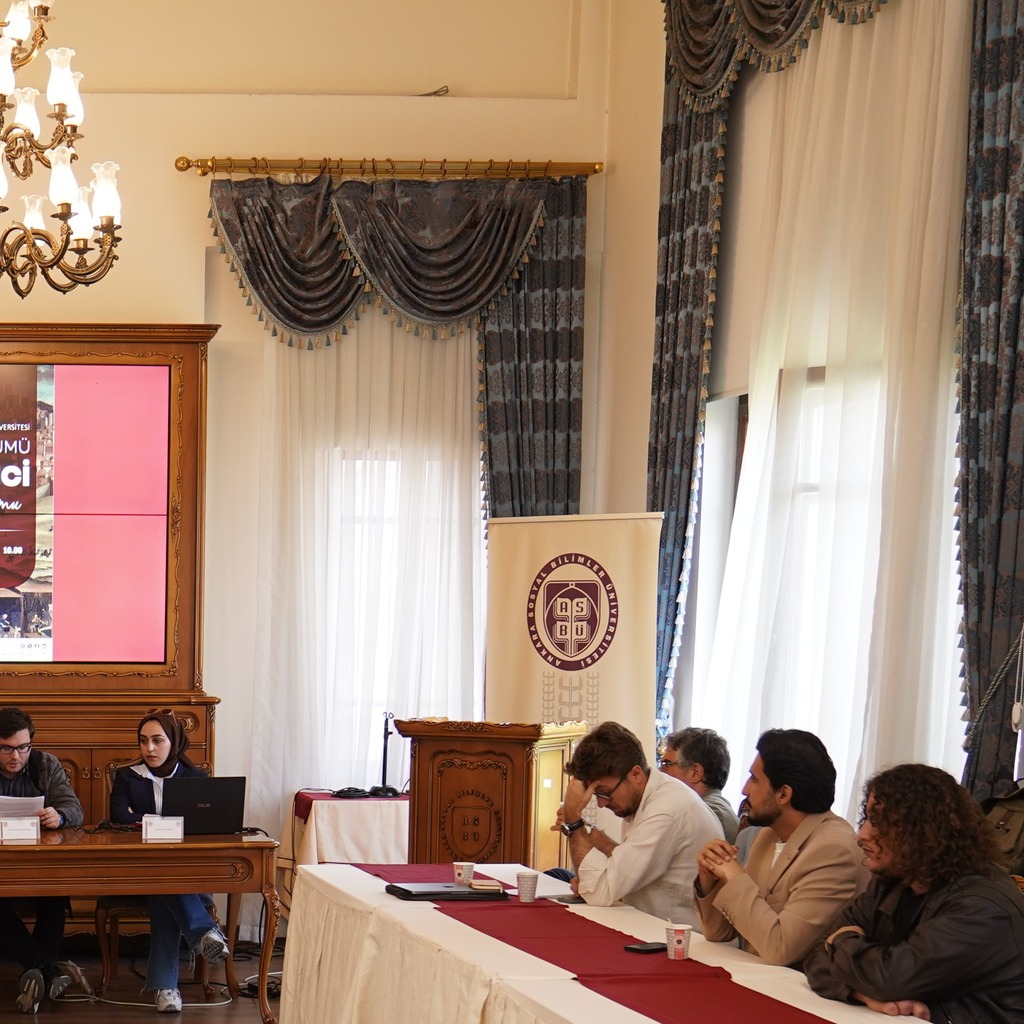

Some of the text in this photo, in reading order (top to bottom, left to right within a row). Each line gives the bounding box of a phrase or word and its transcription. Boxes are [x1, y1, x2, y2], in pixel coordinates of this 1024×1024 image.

[528, 553, 618, 668] ANKARA SOSYAL BİLİMLER ÜNİVERSİTESİ
